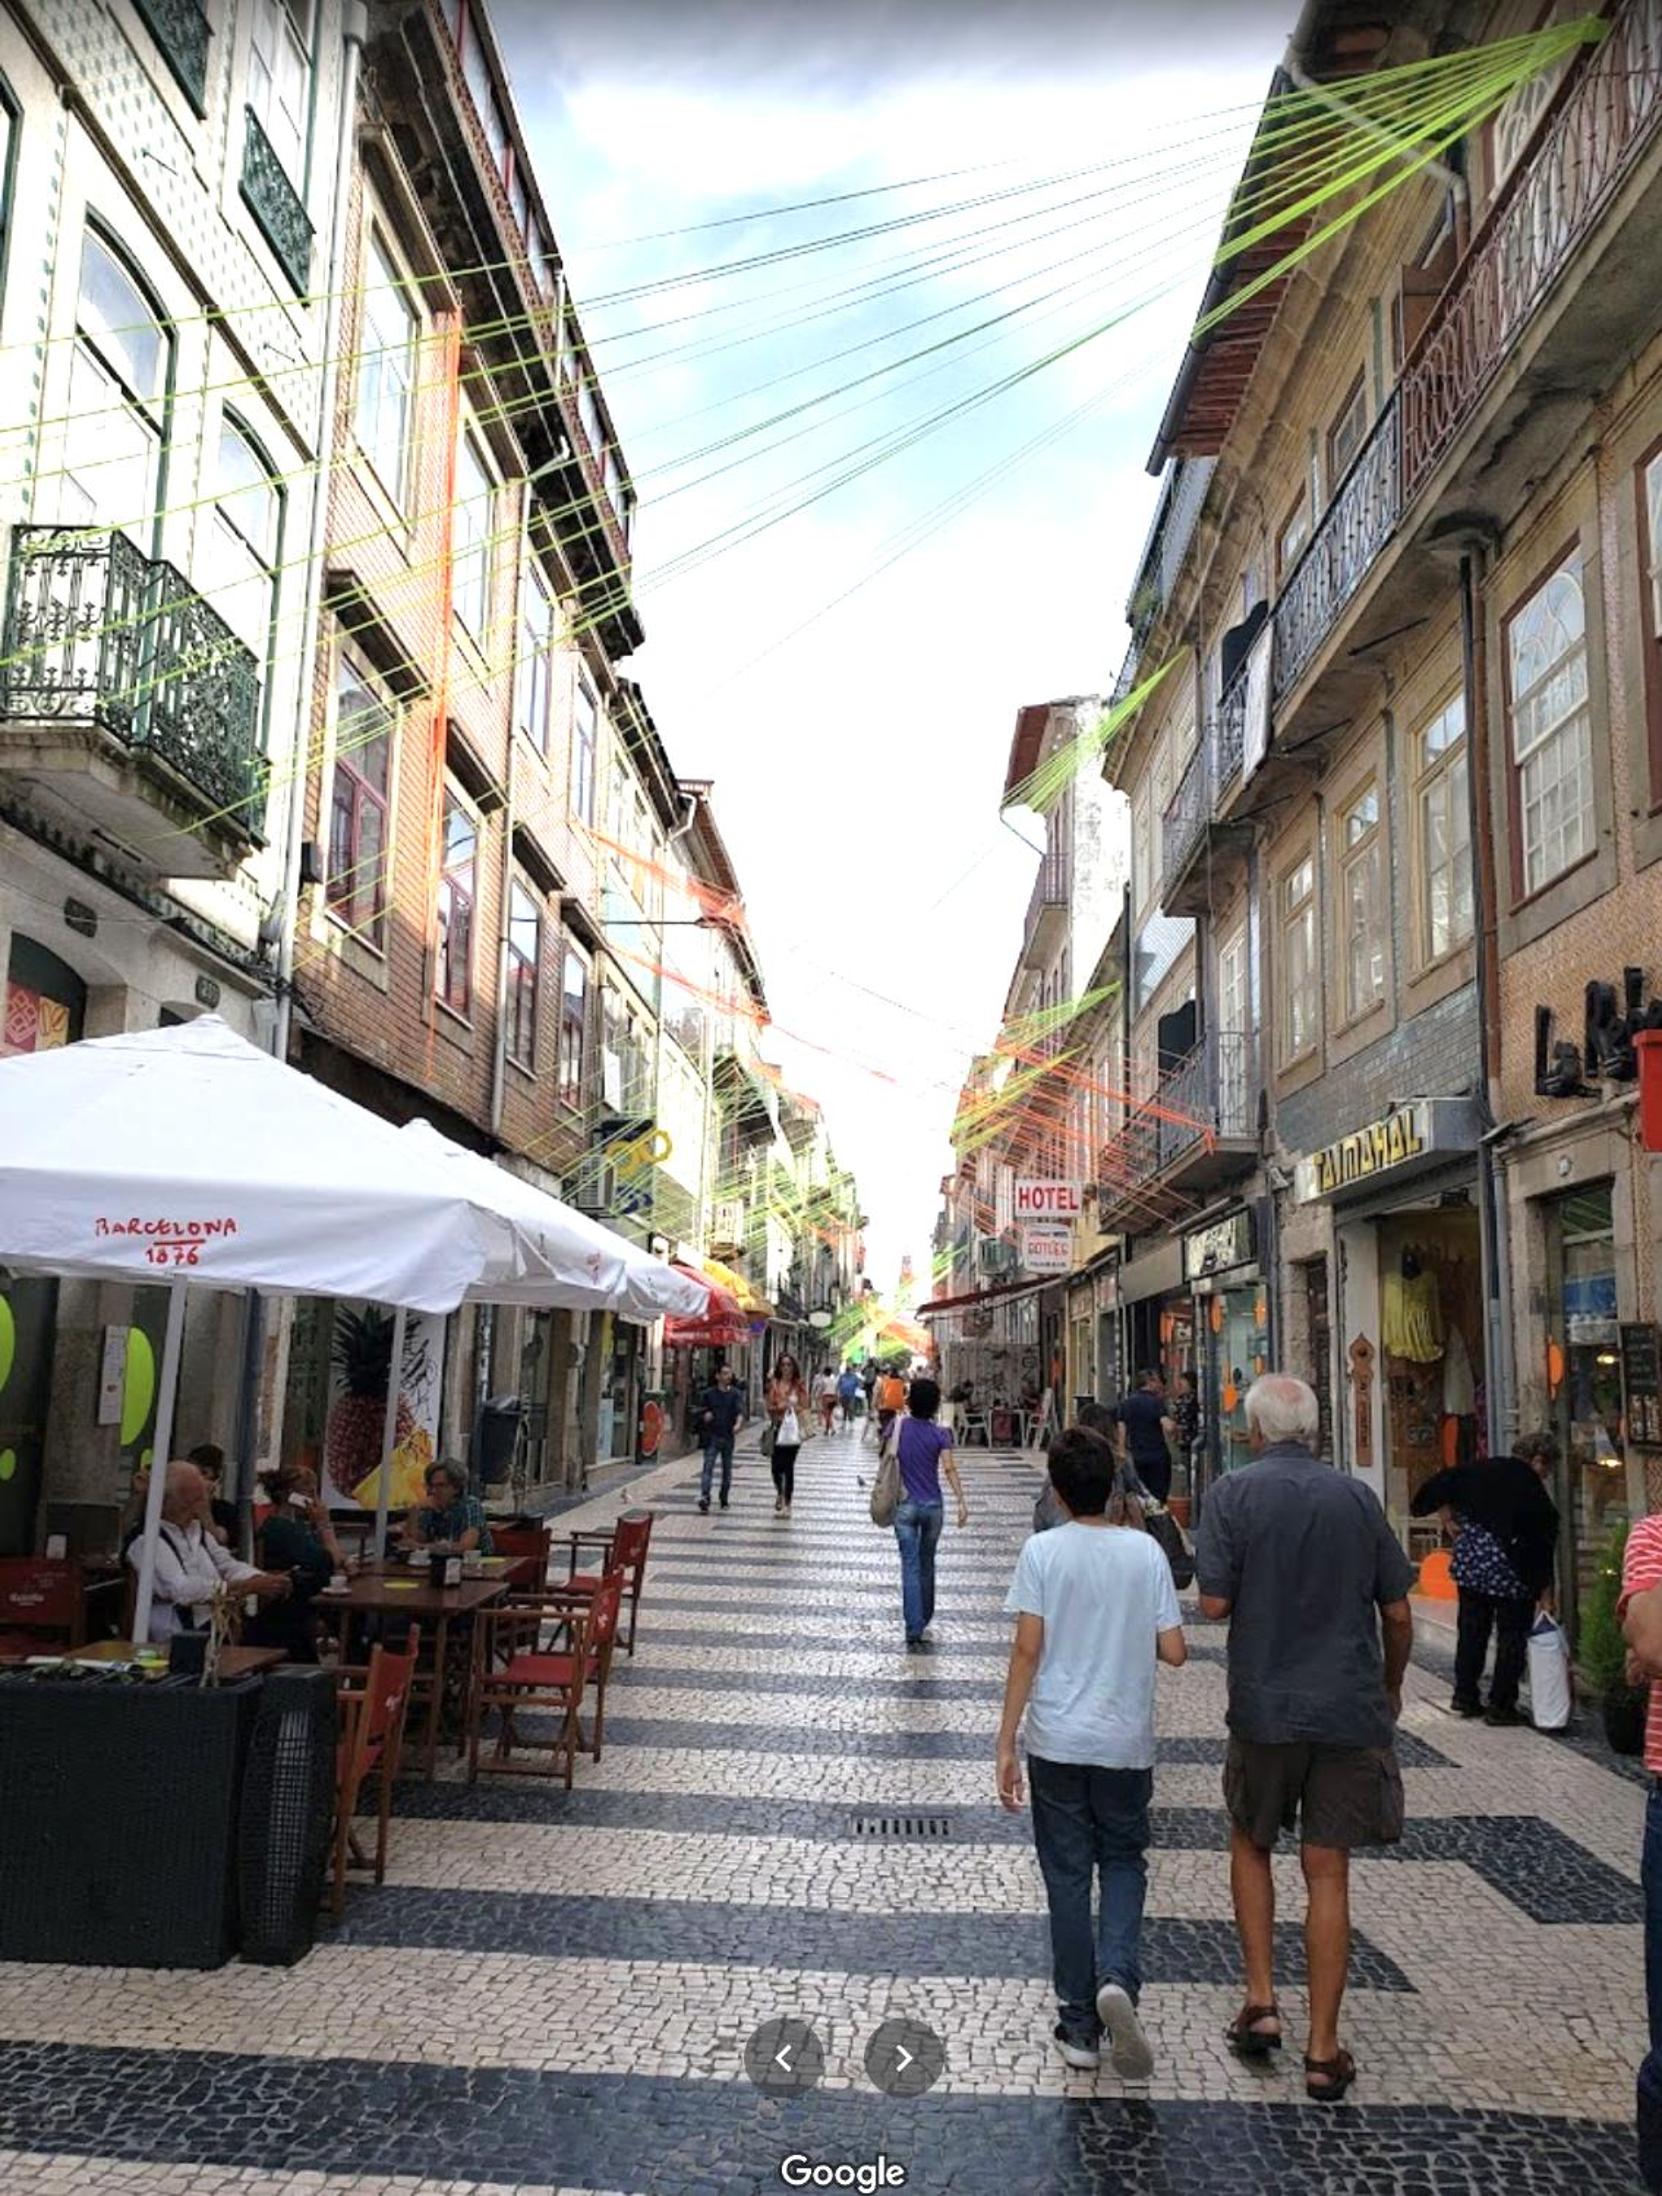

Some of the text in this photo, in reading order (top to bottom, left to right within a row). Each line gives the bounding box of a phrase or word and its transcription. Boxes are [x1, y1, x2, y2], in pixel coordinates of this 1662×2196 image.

[1018, 1186, 1079, 1210] HOTEL
[95, 1217, 237, 1236] BARCELONA
[145, 1247, 199, 1265] 1876
